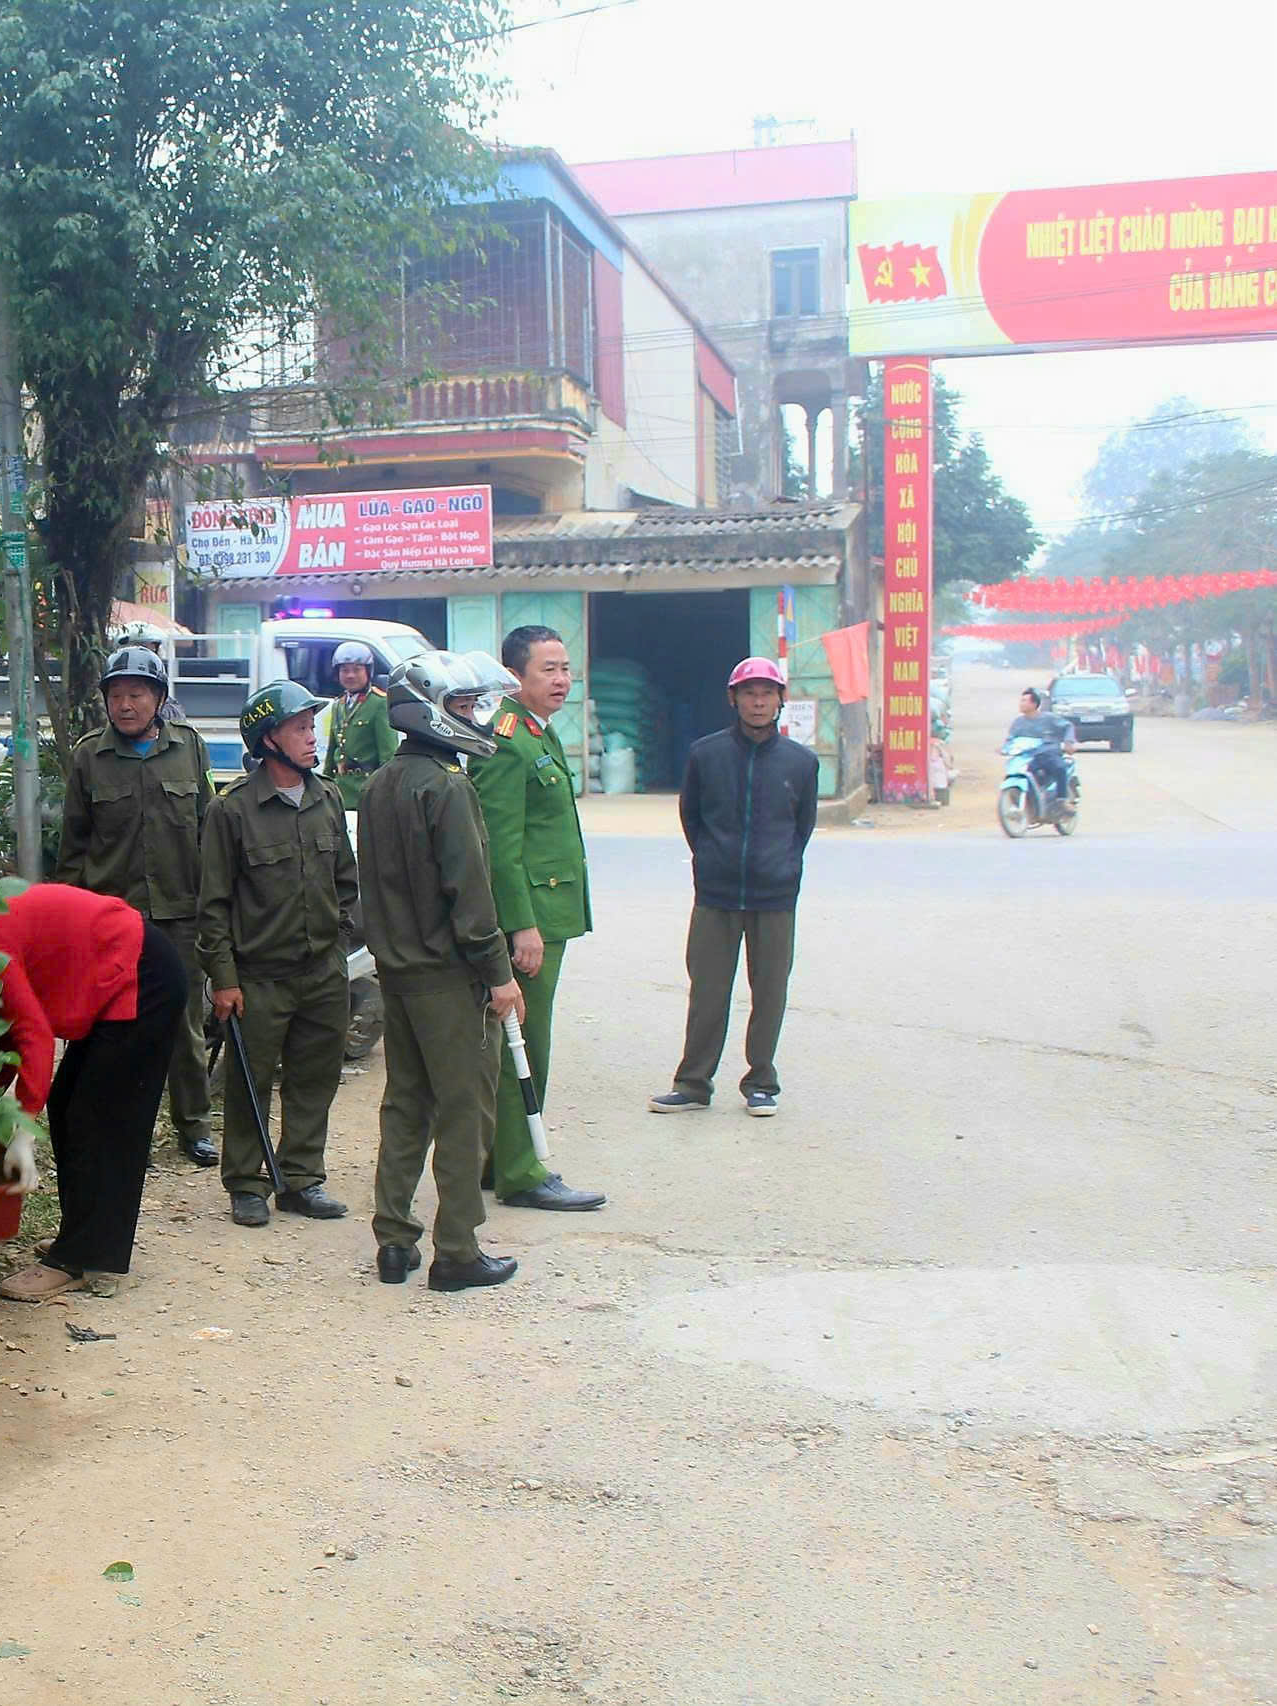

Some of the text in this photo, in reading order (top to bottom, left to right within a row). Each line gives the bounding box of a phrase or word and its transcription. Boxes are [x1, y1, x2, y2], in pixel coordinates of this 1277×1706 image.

[1026, 211, 1074, 265] NHIỆT
[1079, 209, 1115, 264] LIỆT
[1118, 206, 1165, 253] CHÀO
[1169, 202, 1224, 250] MỪNG
[1233, 207, 1265, 253] ĐẠI
[1169, 257, 1205, 311] CỦA
[1209, 256, 1259, 310] ĐẢNG
[891, 380, 922, 404] NƯỚC
[891, 416, 922, 444] CỘNG
[899, 484, 915, 508] XÃ
[296, 502, 346, 529] MUA
[897, 518, 916, 548] HỘI
[298, 536, 346, 568] BÁN
[895, 550, 918, 577] CHỦ
[889, 587, 924, 613] NGHĨA
[894, 622, 918, 651] VIỆT
[893, 661, 919, 682] NAM
